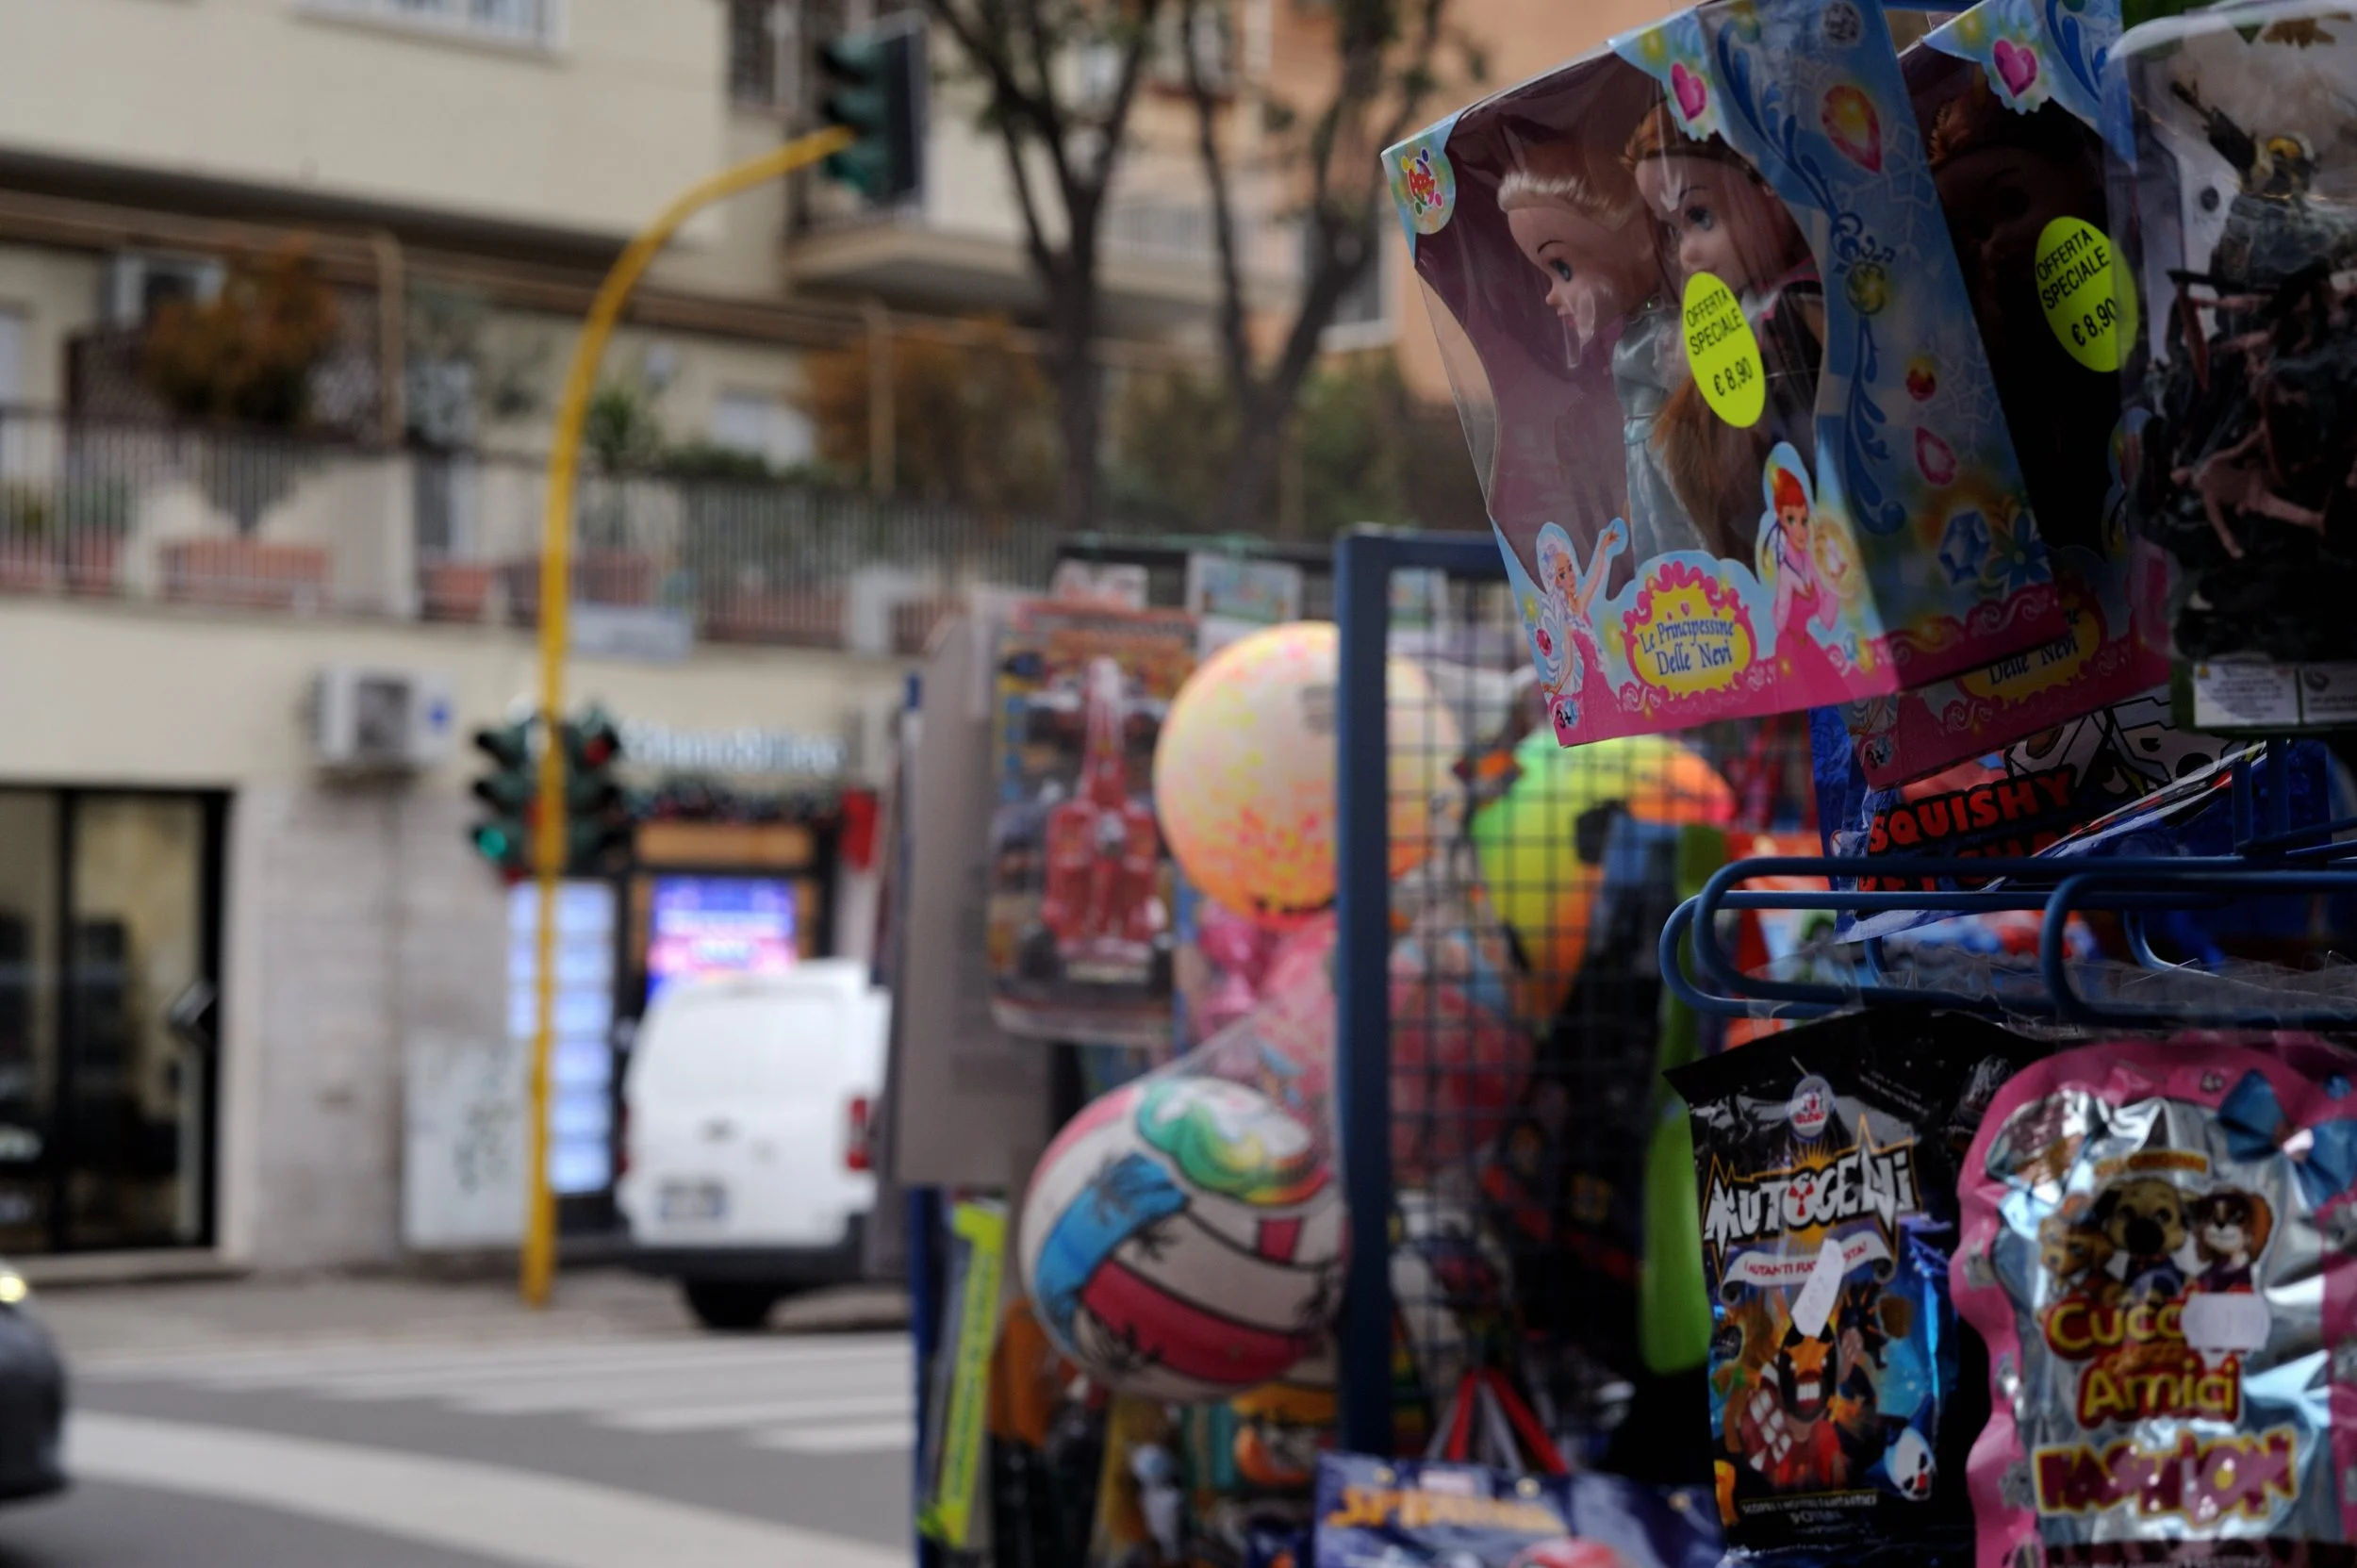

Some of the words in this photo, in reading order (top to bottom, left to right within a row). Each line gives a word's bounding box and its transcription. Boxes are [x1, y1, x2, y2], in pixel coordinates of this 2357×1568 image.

[2036, 227, 2094, 281] OFFERTA
[2042, 245, 2110, 309] SPECIALE
[1686, 288, 1730, 327] OFFERTA
[2071, 323, 2086, 347] €
[2084, 297, 2119, 338] 8,90
[1689, 307, 1743, 356] SPECIALE
[1713, 373, 1725, 396] €
[1723, 355, 1754, 390] 8,90
[1639, 633, 1656, 654] Le
[1656, 619, 1735, 647] Principessine
[1656, 641, 1691, 675] Delle
[1698, 638, 1733, 668] Nevi
[1556, 709, 1572, 729] 3+
[1866, 750, 1885, 769] 3+
[1870, 772, 2071, 853] SQUISHY
[2084, 1356, 2235, 1419] Amici
